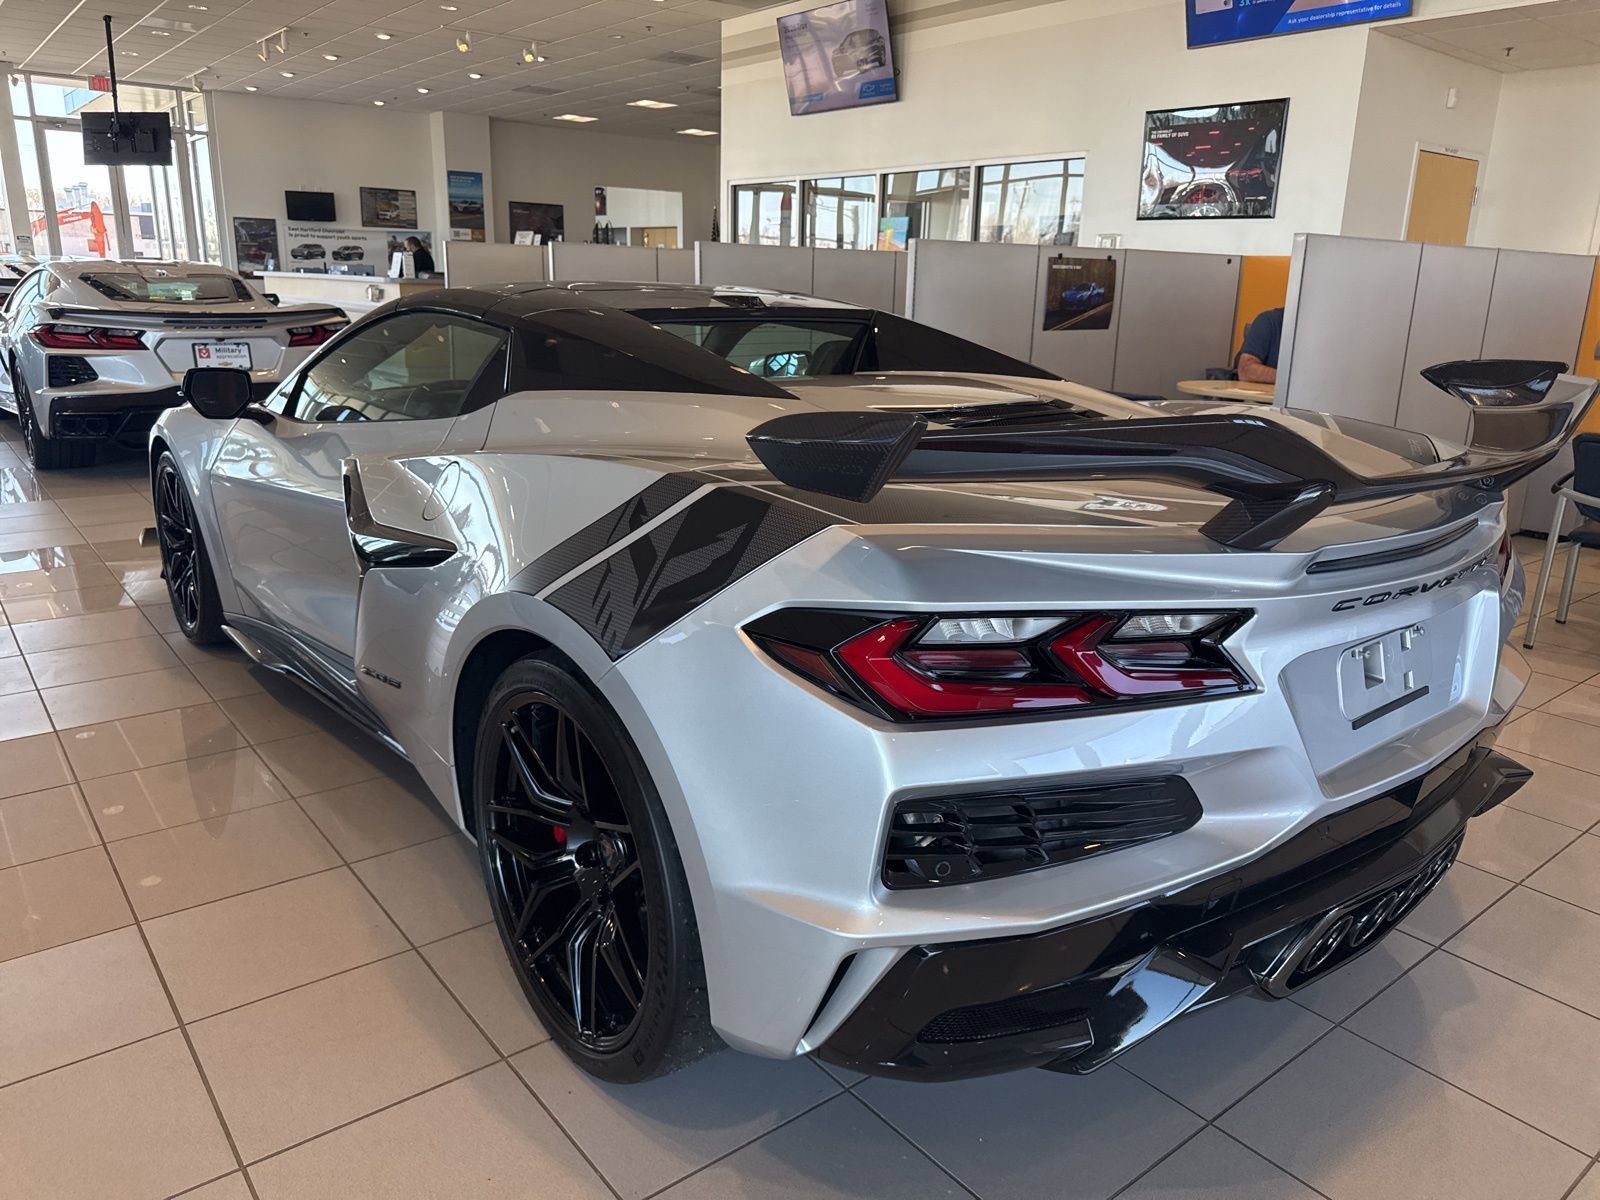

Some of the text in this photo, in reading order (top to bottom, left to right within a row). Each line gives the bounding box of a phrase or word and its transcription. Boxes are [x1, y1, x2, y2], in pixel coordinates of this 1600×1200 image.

[1309, 12, 1335, 21] dealership
[1335, 7, 1374, 17] representative
[91, 77, 111, 90] EXIT
